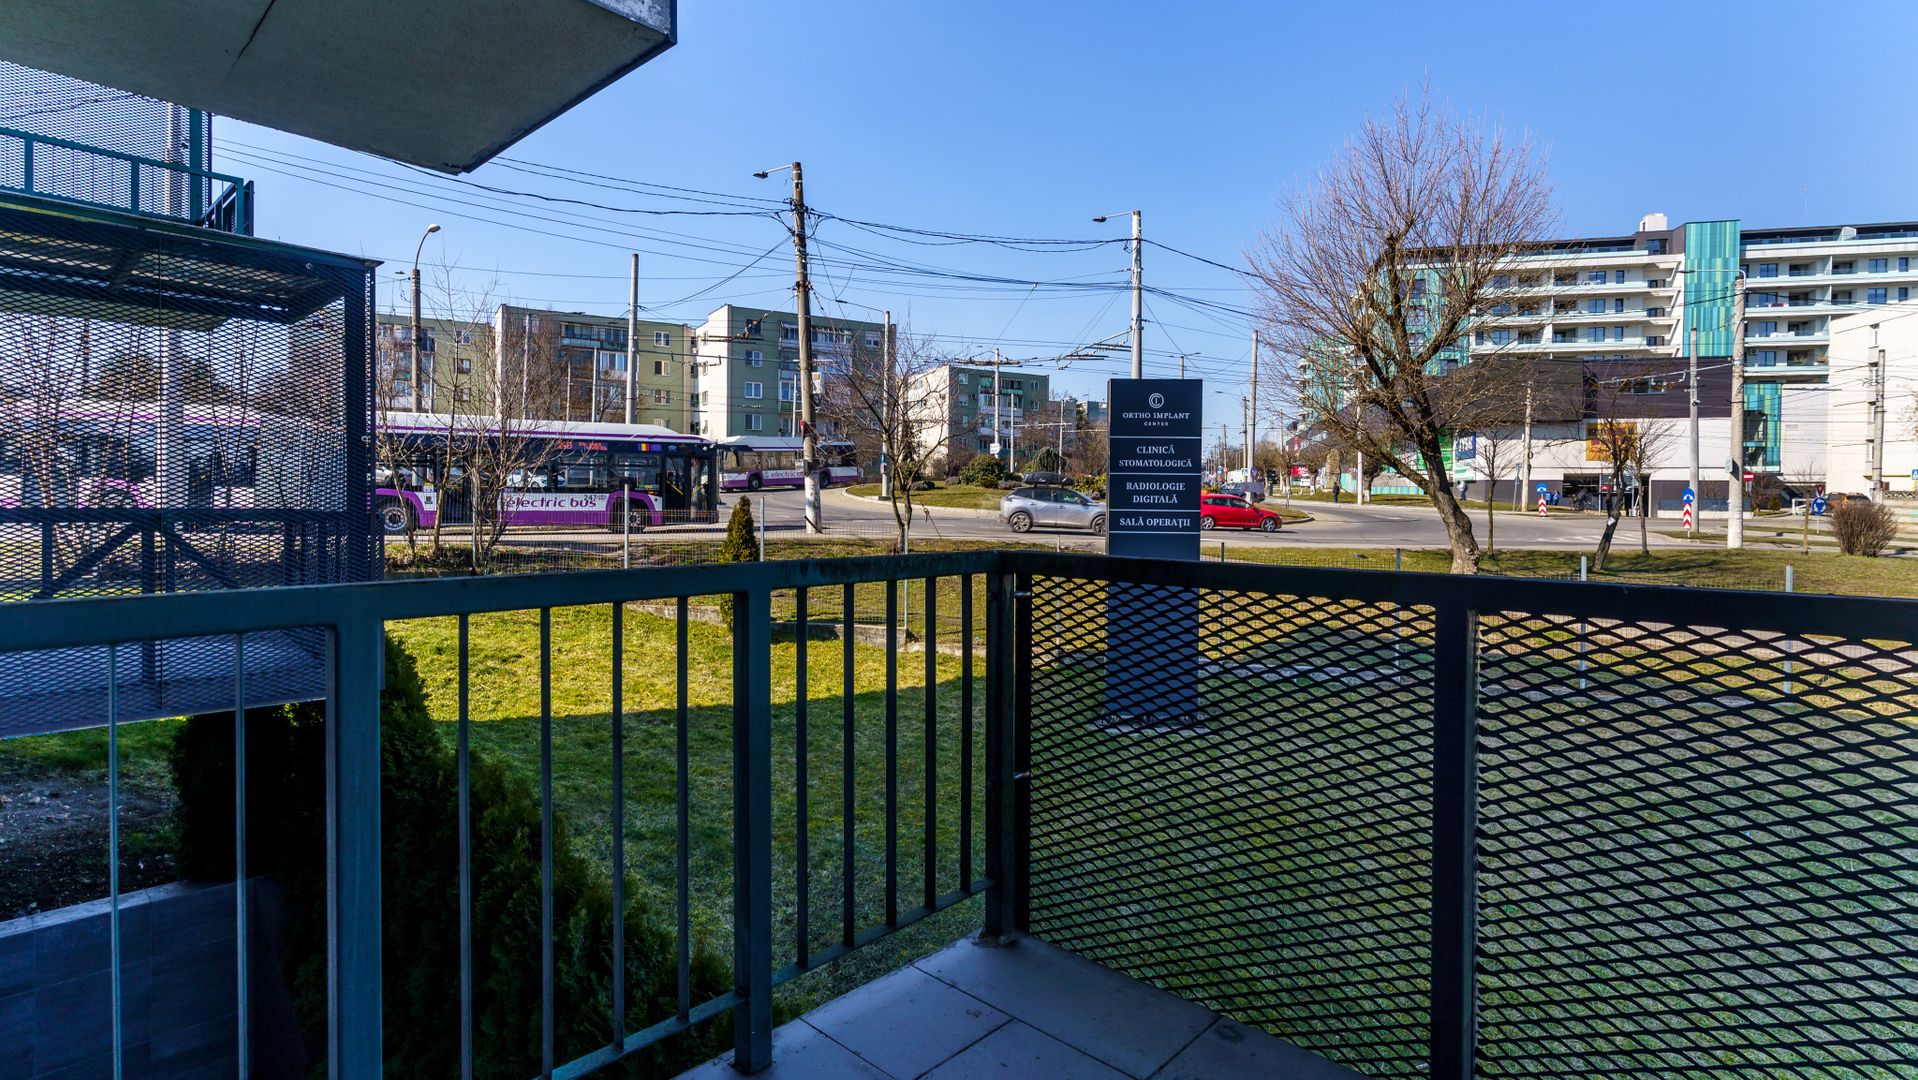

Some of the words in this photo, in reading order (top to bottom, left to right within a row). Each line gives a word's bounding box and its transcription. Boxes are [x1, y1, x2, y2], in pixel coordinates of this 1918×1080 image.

[1136, 444, 1175, 454] CLINICĂ
[1119, 459, 1192, 468] STOMATOLOGICĂ
[1126, 482, 1185, 491] RADIOLOGIE
[507, 497, 566, 508] electric
[569, 497, 597, 508] bus
[1133, 494, 1178, 504] DIGITALĂ
[1119, 517, 1144, 526] SALĂ
